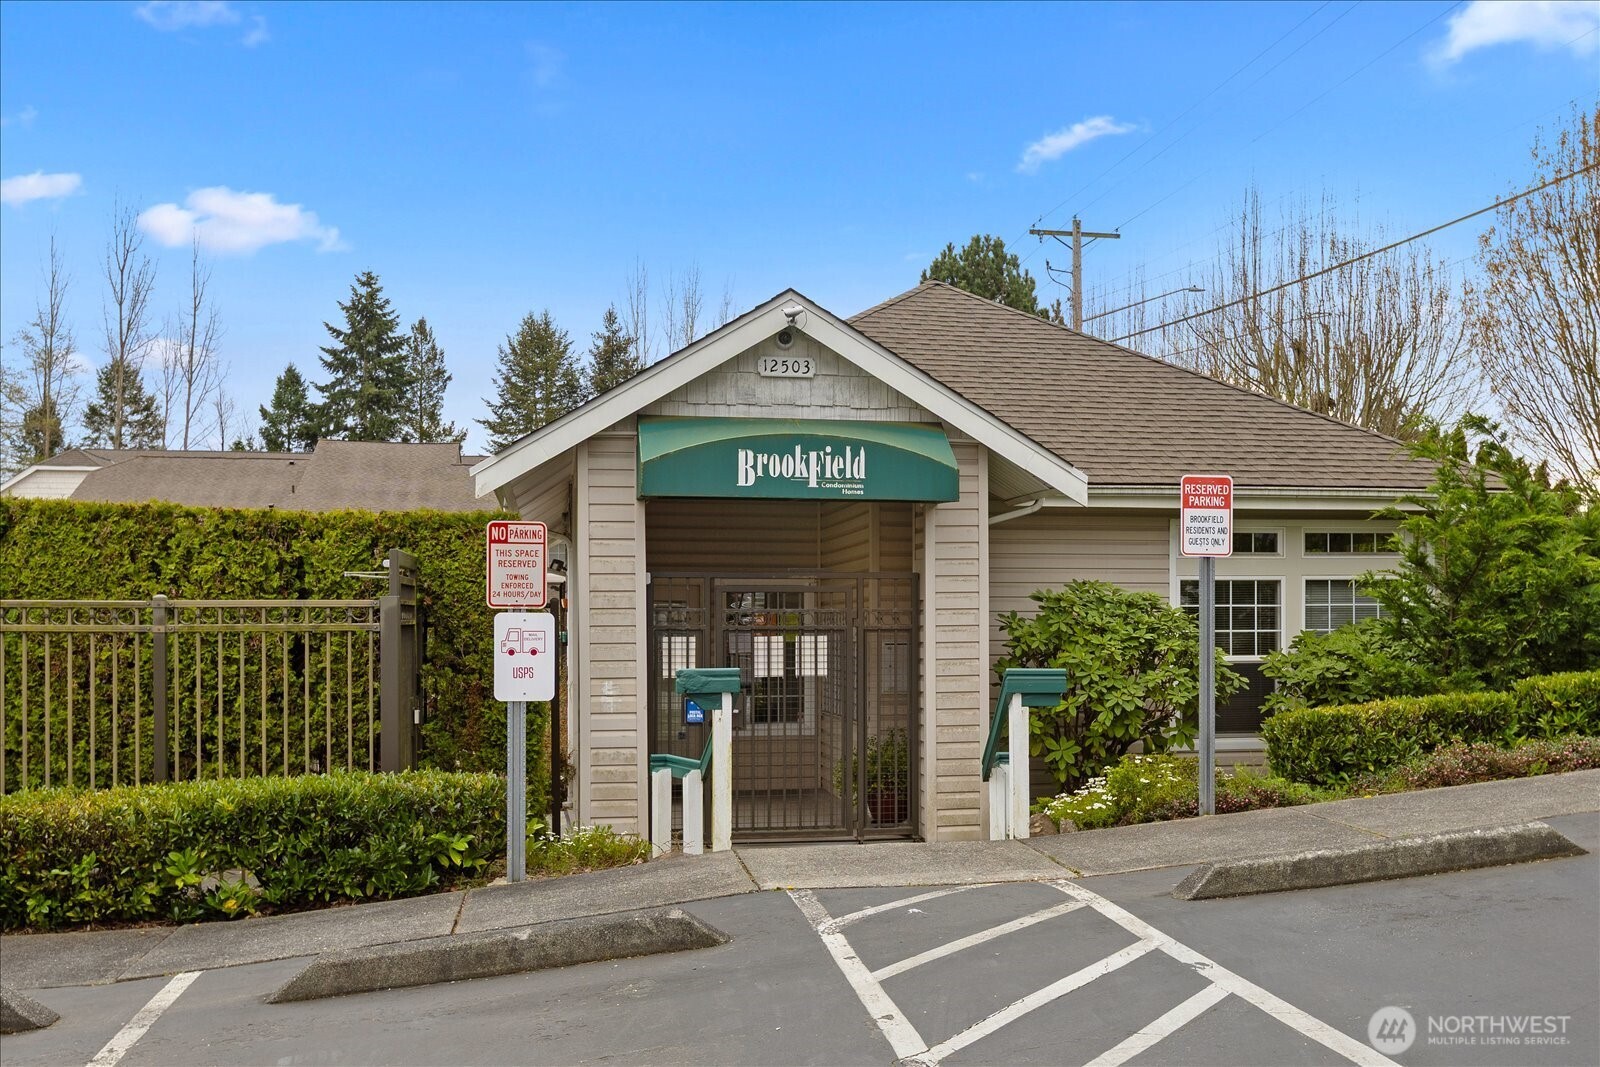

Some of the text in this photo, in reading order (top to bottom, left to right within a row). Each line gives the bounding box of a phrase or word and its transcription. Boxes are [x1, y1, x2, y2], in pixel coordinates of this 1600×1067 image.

[764, 359, 810, 374] 12503
[1184, 484, 1229, 494] RESERVED
[1189, 496, 1225, 506] PARKING
[1190, 516, 1224, 524] BROOKFIELD
[492, 526, 542, 540] NO PARKING
[1186, 526, 1216, 534] RESIDENTS
[1188, 538, 1226, 546] GUESTS ONLY
[503, 591, 541, 600] HOURS/DAY
[513, 667, 534, 679] USPS
